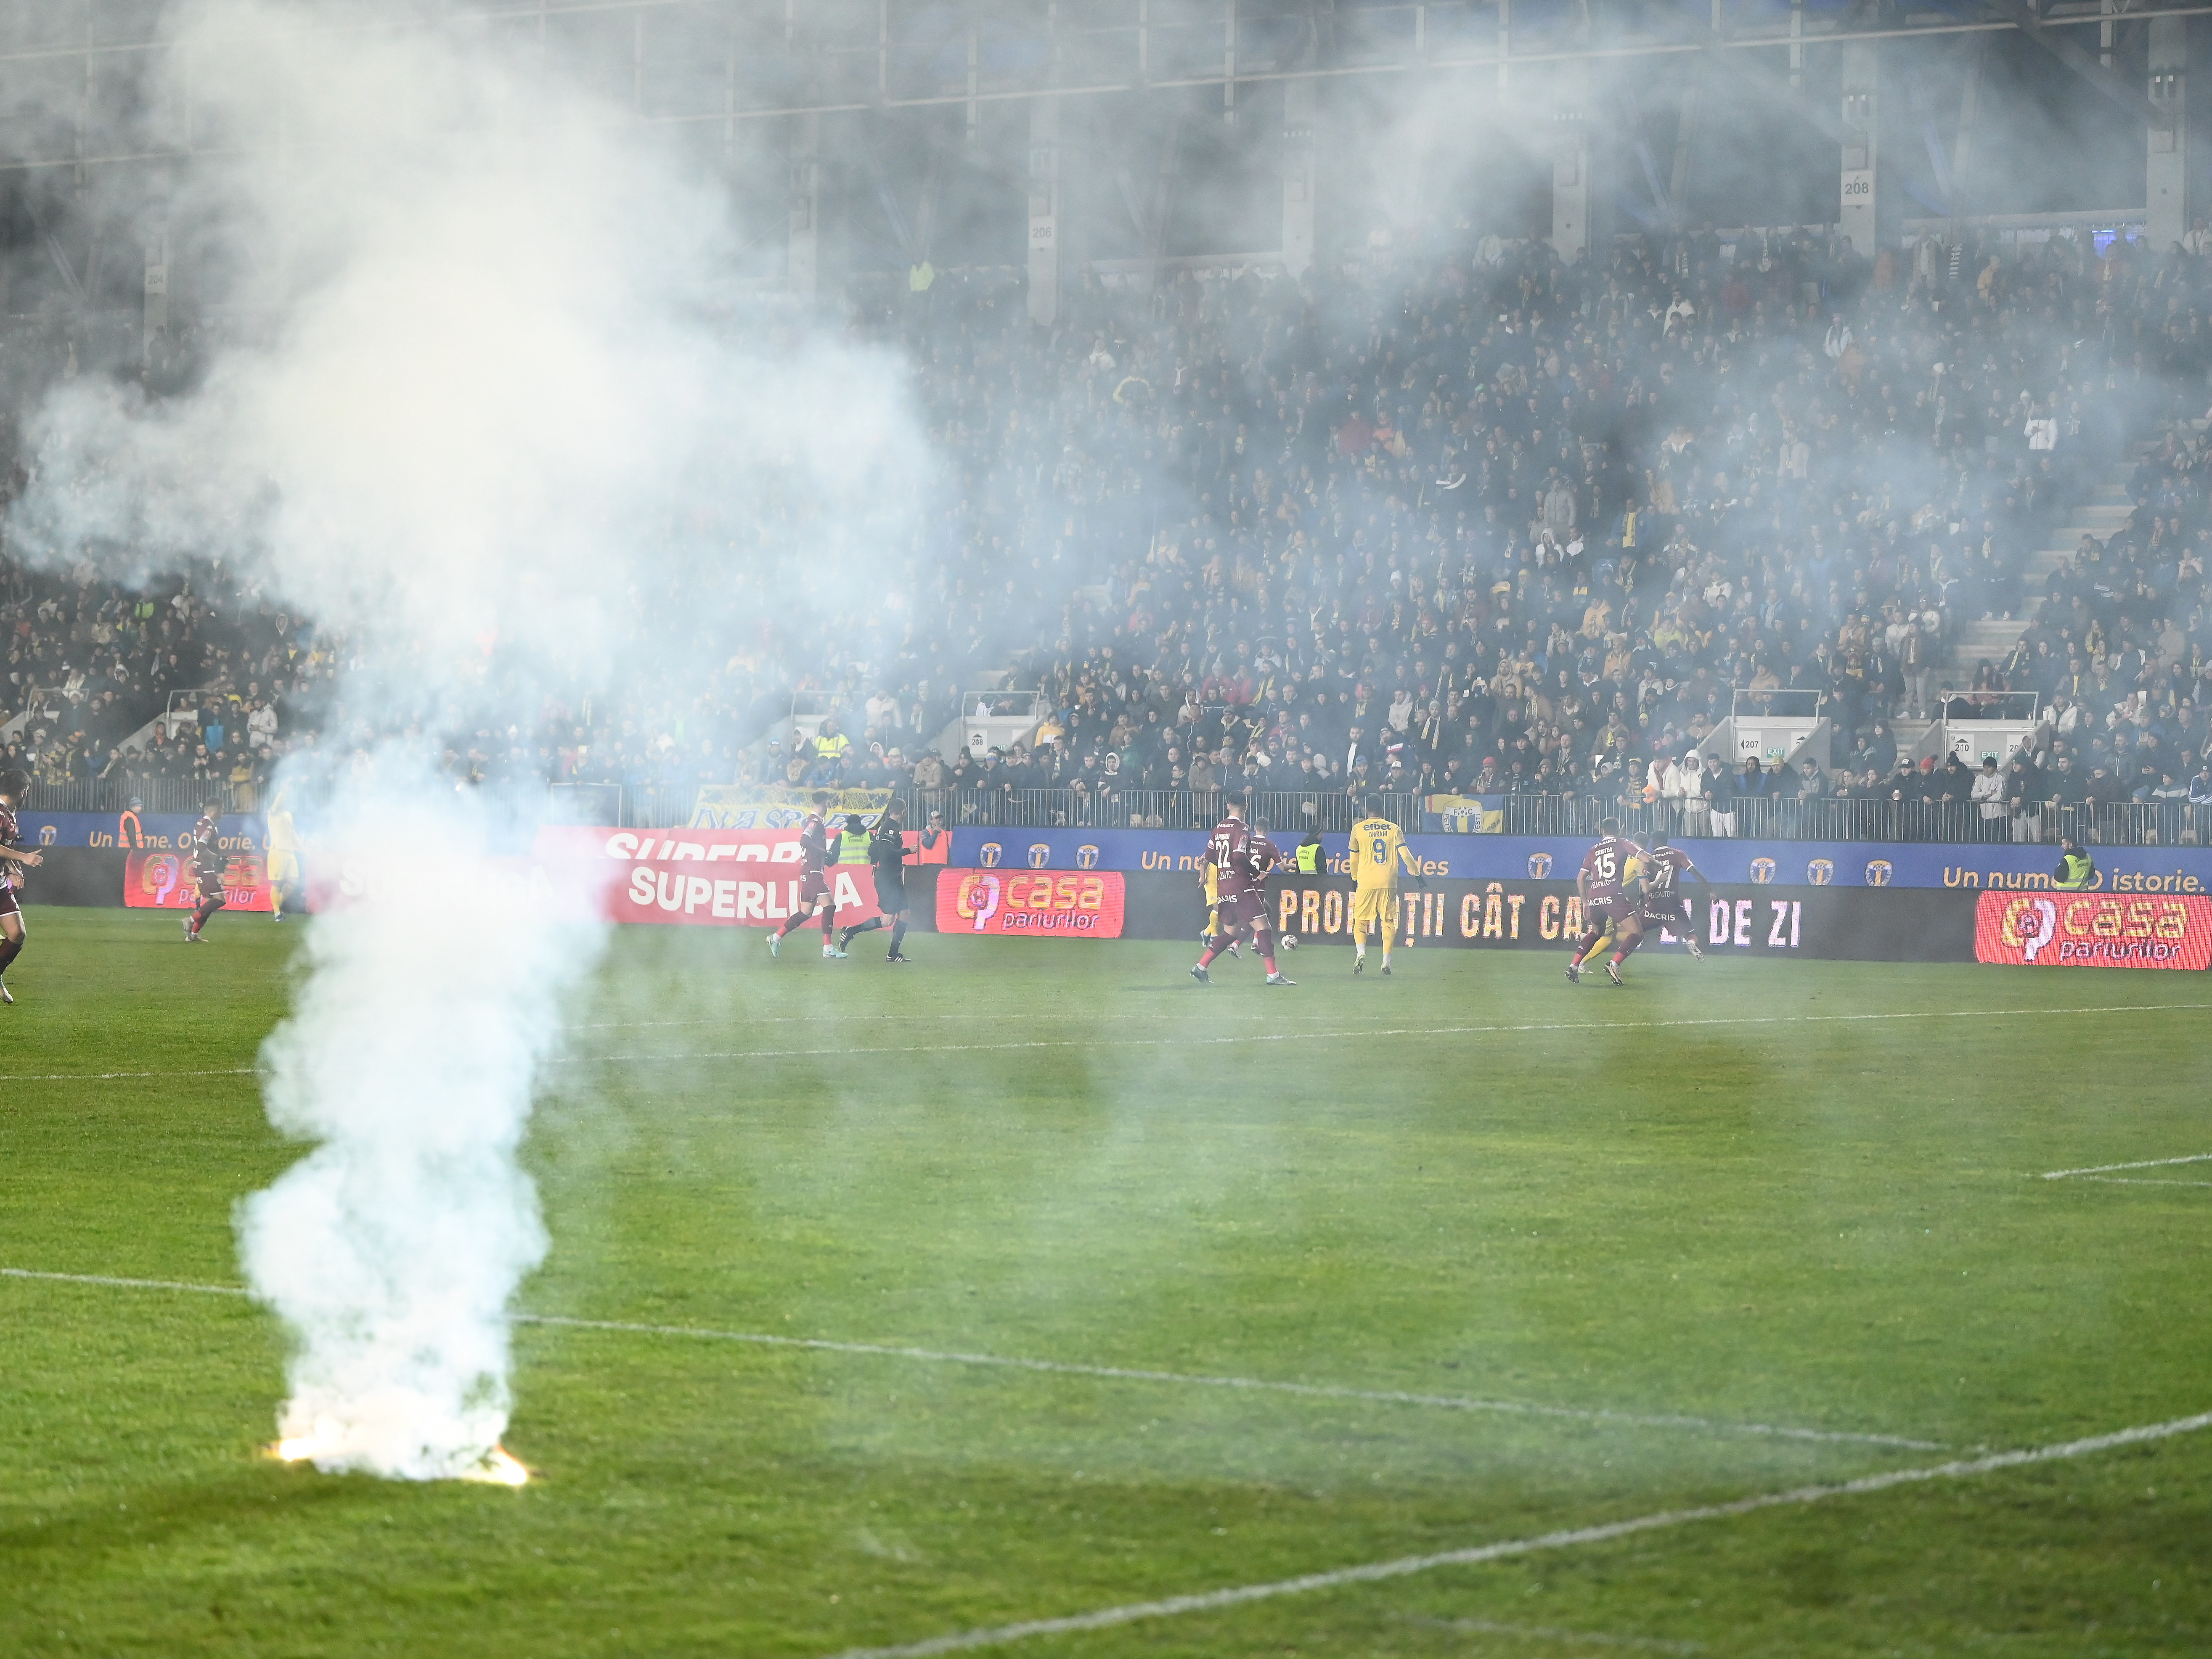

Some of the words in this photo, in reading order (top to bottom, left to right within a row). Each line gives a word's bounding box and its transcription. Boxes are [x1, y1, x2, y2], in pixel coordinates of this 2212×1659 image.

[1845, 182, 1869, 194] 208
[1033, 227, 1052, 238] 206
[90, 831, 113, 847] Un
[144, 835, 172, 849] me.
[178, 832, 192, 849] O
[218, 831, 256, 849] orie.
[1373, 839, 1387, 864] 9
[1595, 847, 1613, 856] CRISTEA
[1142, 851, 1171, 870] Un
[1216, 840, 1231, 869] 22
[1594, 852, 1616, 880] 15
[183, 856, 262, 886] csa
[1944, 867, 1979, 887] Un
[1988, 872, 2058, 889] num
[2112, 868, 2205, 892] istorie.
[628, 866, 863, 919] SUPERLIA
[1007, 876, 1104, 910] casa
[1002, 910, 1099, 931] pariurilor
[1279, 889, 1444, 947] PROȚII
[1460, 881, 1525, 939] CÂT
[1709, 899, 1753, 946] DE
[1768, 901, 1801, 947] ZI
[1644, 910, 1676, 921] DACRIS
[2064, 898, 2188, 938] casa
[2060, 939, 2182, 961] pariurilor
